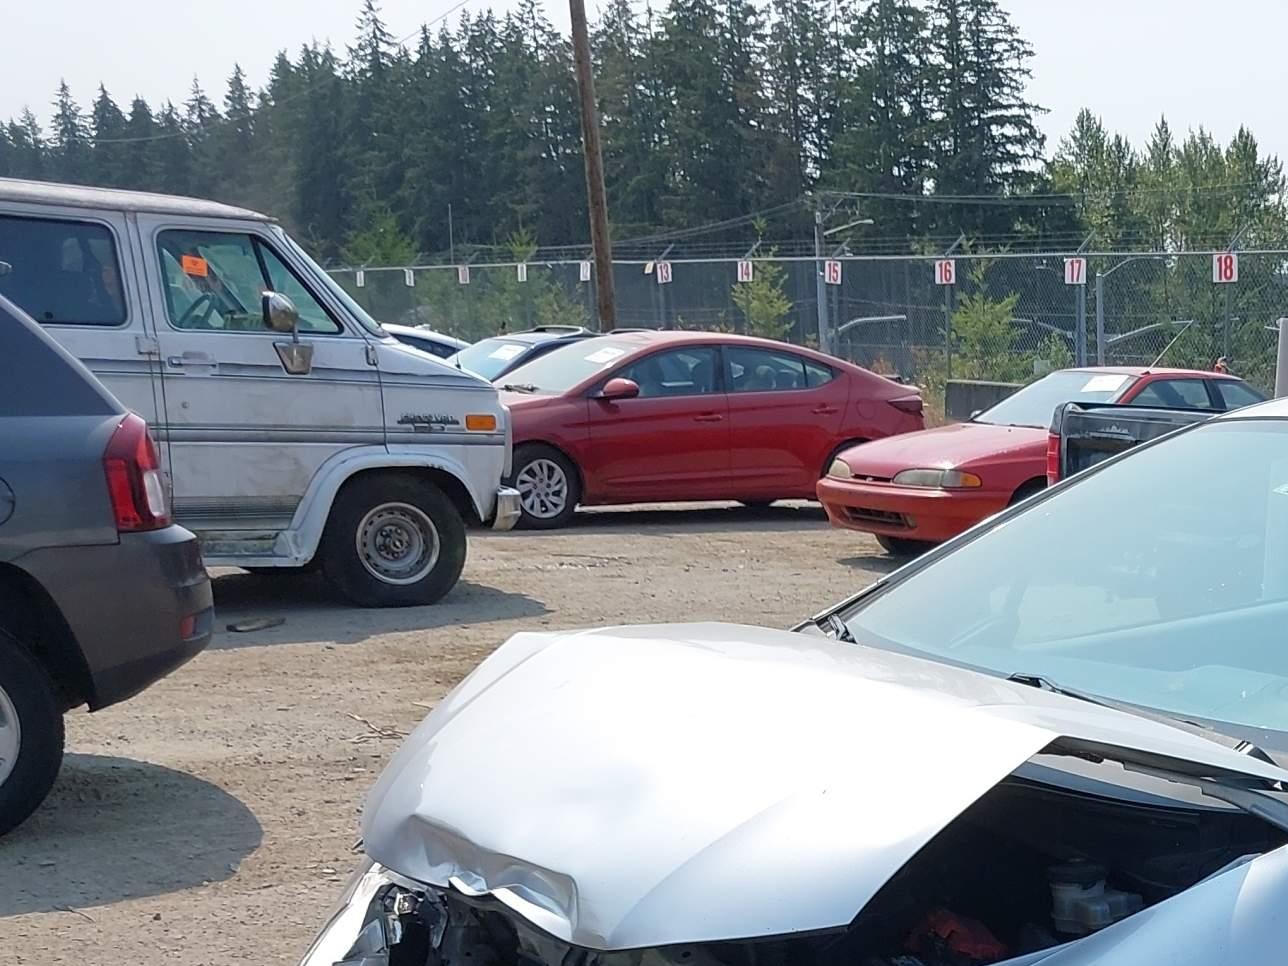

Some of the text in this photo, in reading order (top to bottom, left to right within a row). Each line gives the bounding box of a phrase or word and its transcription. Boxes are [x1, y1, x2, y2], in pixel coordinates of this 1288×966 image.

[659, 263, 669, 281] 13
[740, 263, 750, 280] 14
[828, 264, 839, 281] 15
[938, 262, 951, 282] 16
[1069, 260, 1083, 282] 17
[1216, 255, 1234, 281] 18
